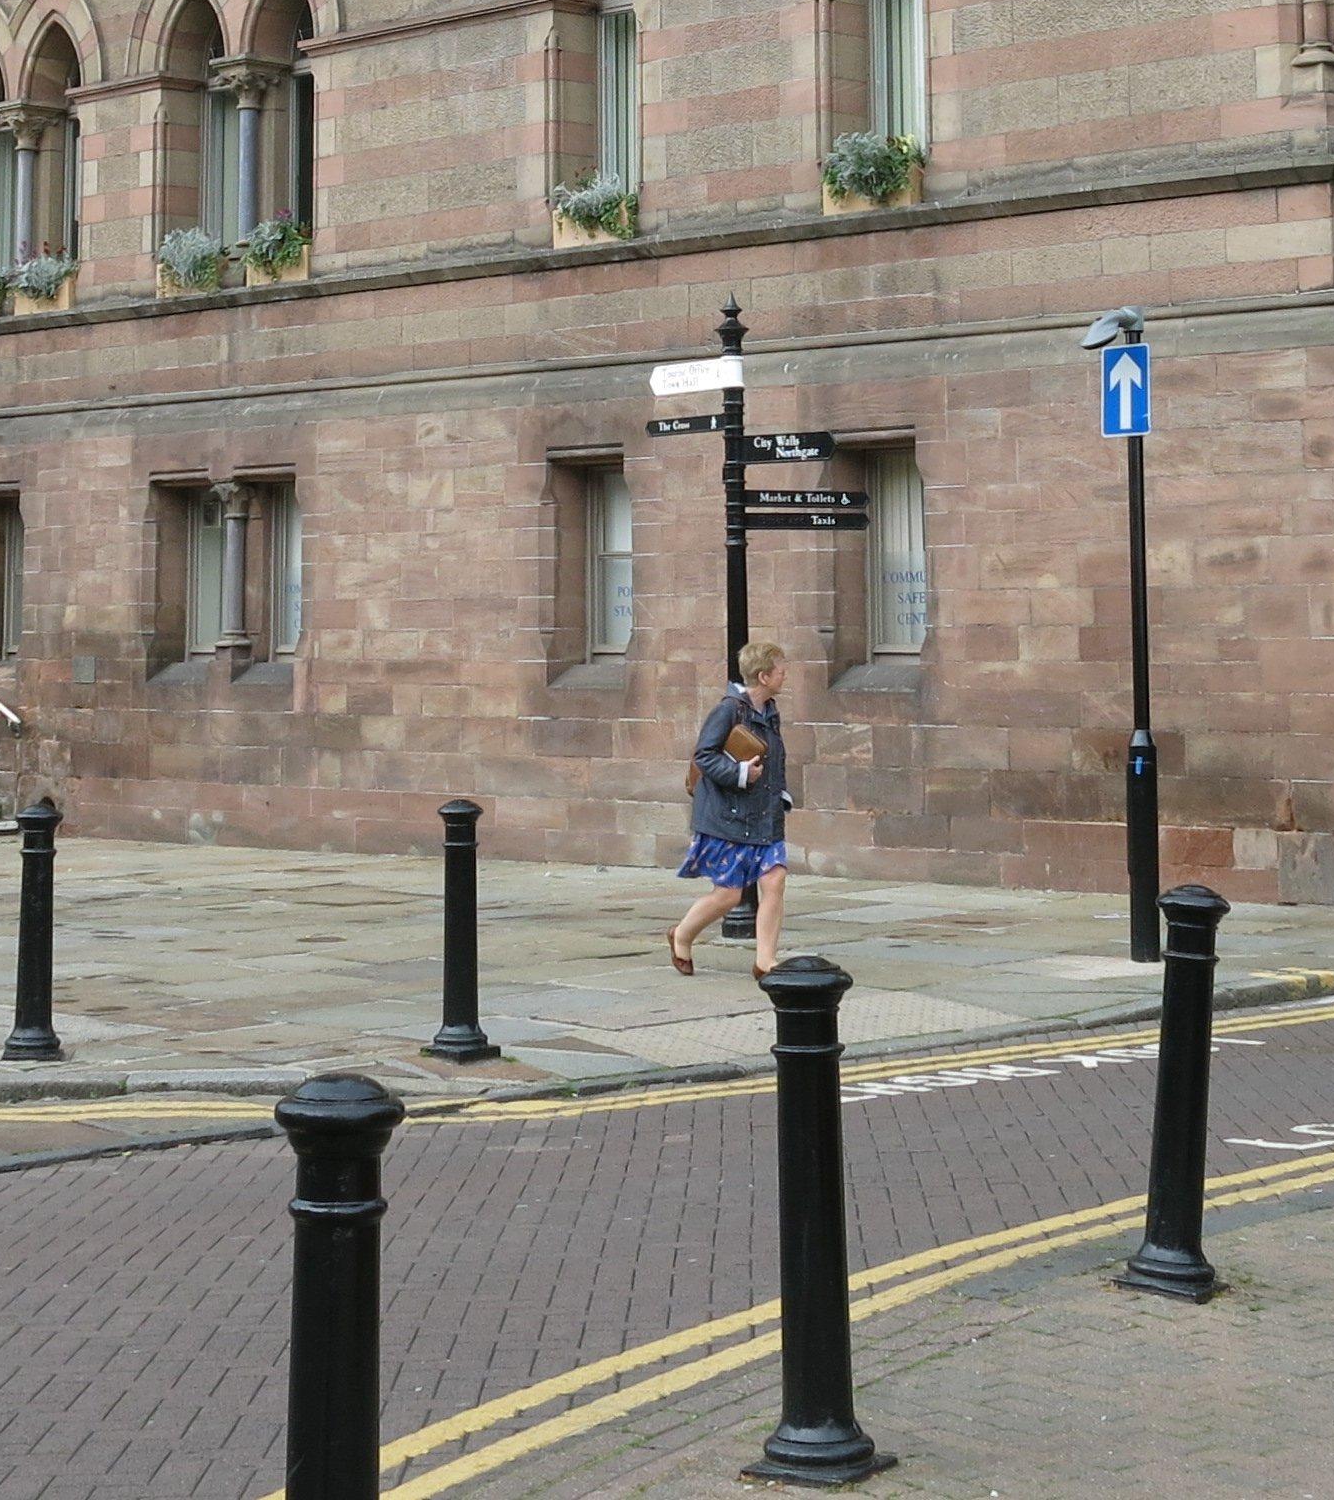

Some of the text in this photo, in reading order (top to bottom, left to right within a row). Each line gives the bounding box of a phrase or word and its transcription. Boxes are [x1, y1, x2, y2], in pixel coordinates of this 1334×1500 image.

[658, 421, 671, 431] The
[753, 435, 800, 450] City Walls
[775, 446, 820, 460] Northgate
[759, 492, 836, 503] Market & Toilets
[810, 515, 836, 525] Taxis
